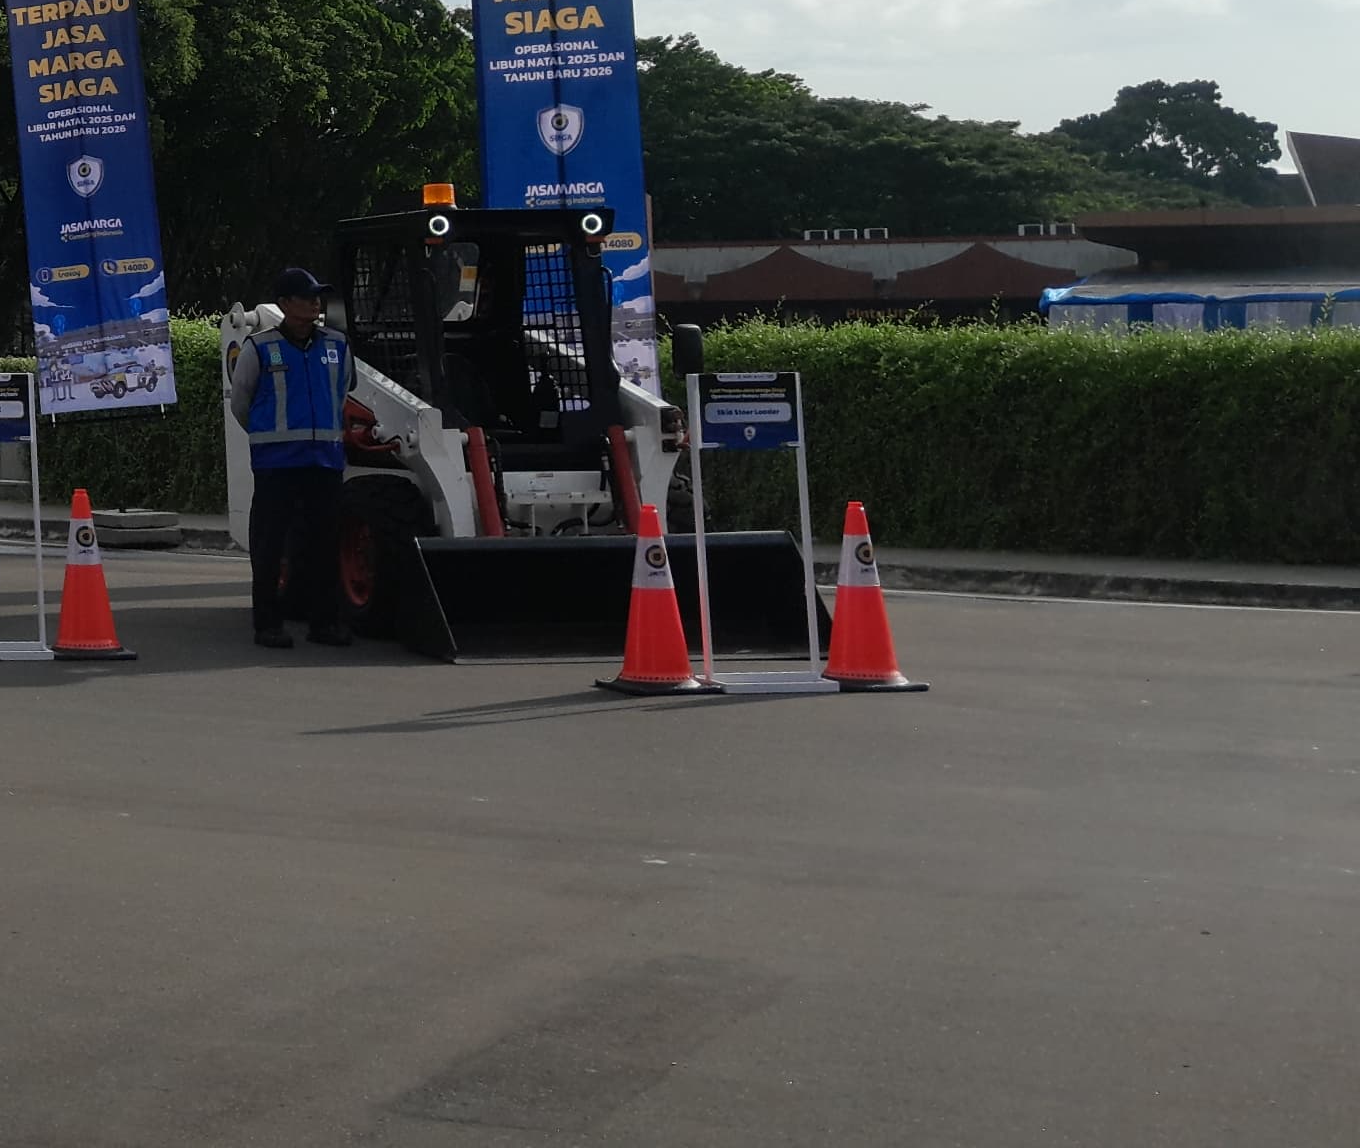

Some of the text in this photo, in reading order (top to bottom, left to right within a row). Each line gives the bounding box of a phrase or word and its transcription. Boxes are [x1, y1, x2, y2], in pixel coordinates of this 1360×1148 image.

[504, 5, 605, 35] SIAGA
[41, 24, 106, 49] JASA
[514, 40, 599, 55] OPERASIONAL
[28, 48, 125, 78] MARGA
[489, 52, 625, 70] LIBUR NATAL 2025 DAN
[504, 66, 613, 83] TAHUN BARU 2026
[38, 76, 119, 103] SIAGA
[47, 104, 114, 119] OPERASIONAL
[27, 112, 136, 133] LIBUR NATAL 2025 DAN
[39, 125, 126, 143] TAHUN BARU 2026
[524, 182, 605, 197] JASAMARGA
[60, 218, 123, 234] JASAMARGA
